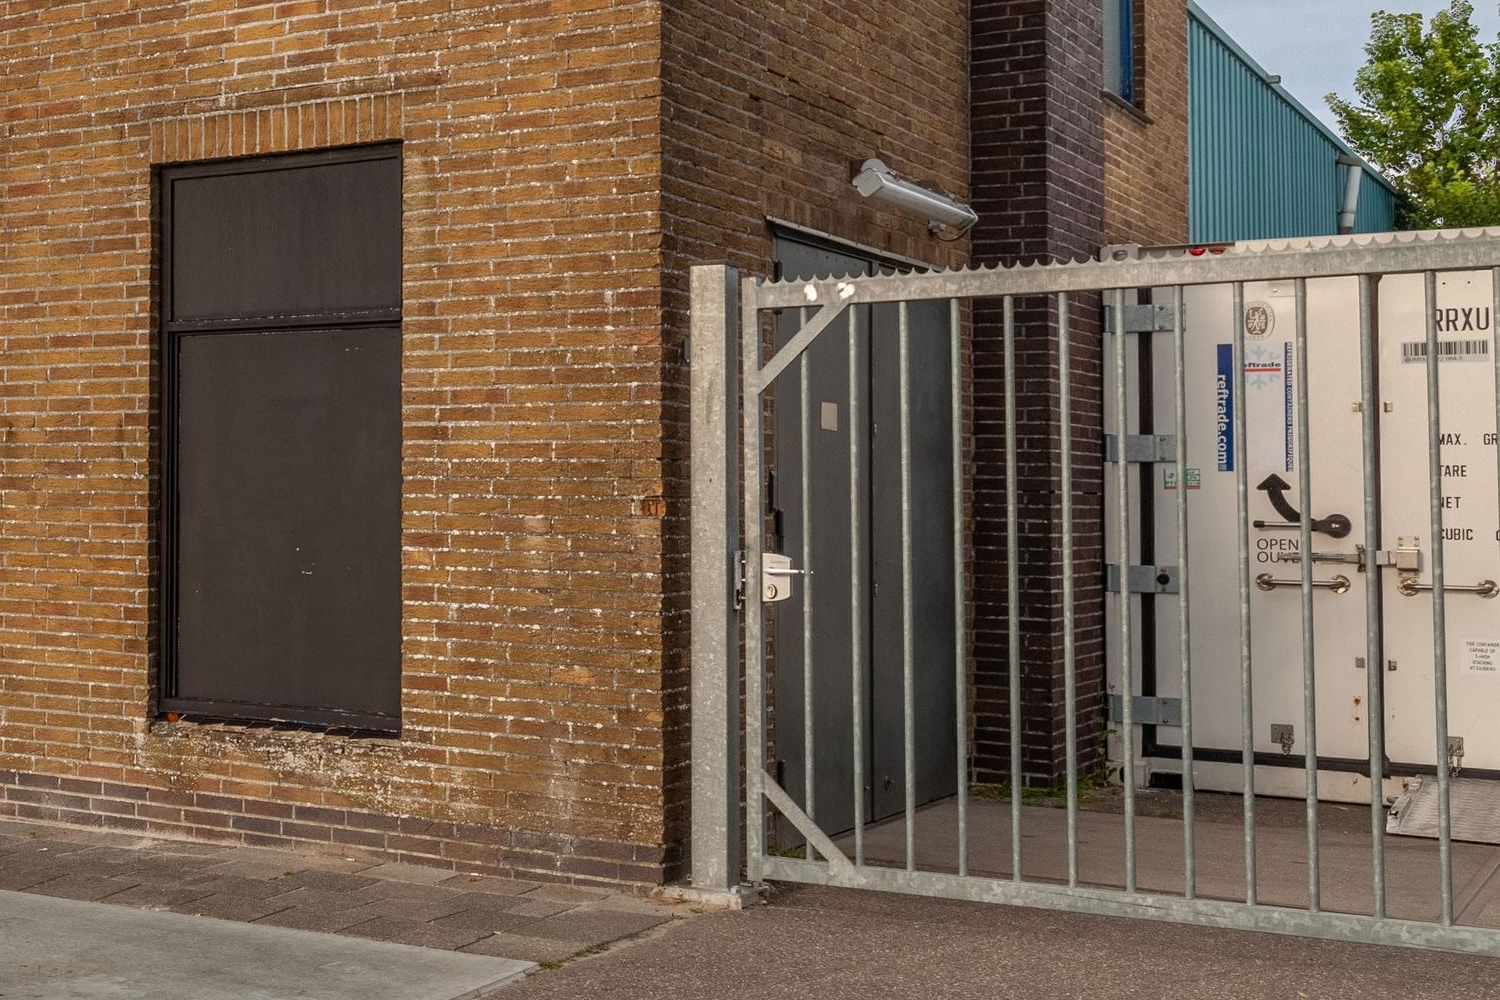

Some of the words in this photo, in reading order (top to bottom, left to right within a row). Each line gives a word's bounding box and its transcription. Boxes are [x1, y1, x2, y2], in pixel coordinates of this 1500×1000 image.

[1436, 307, 1490, 332] RRXU
[1217, 374, 1229, 464] reftrade.com
[1256, 538, 1299, 551] OPEN
